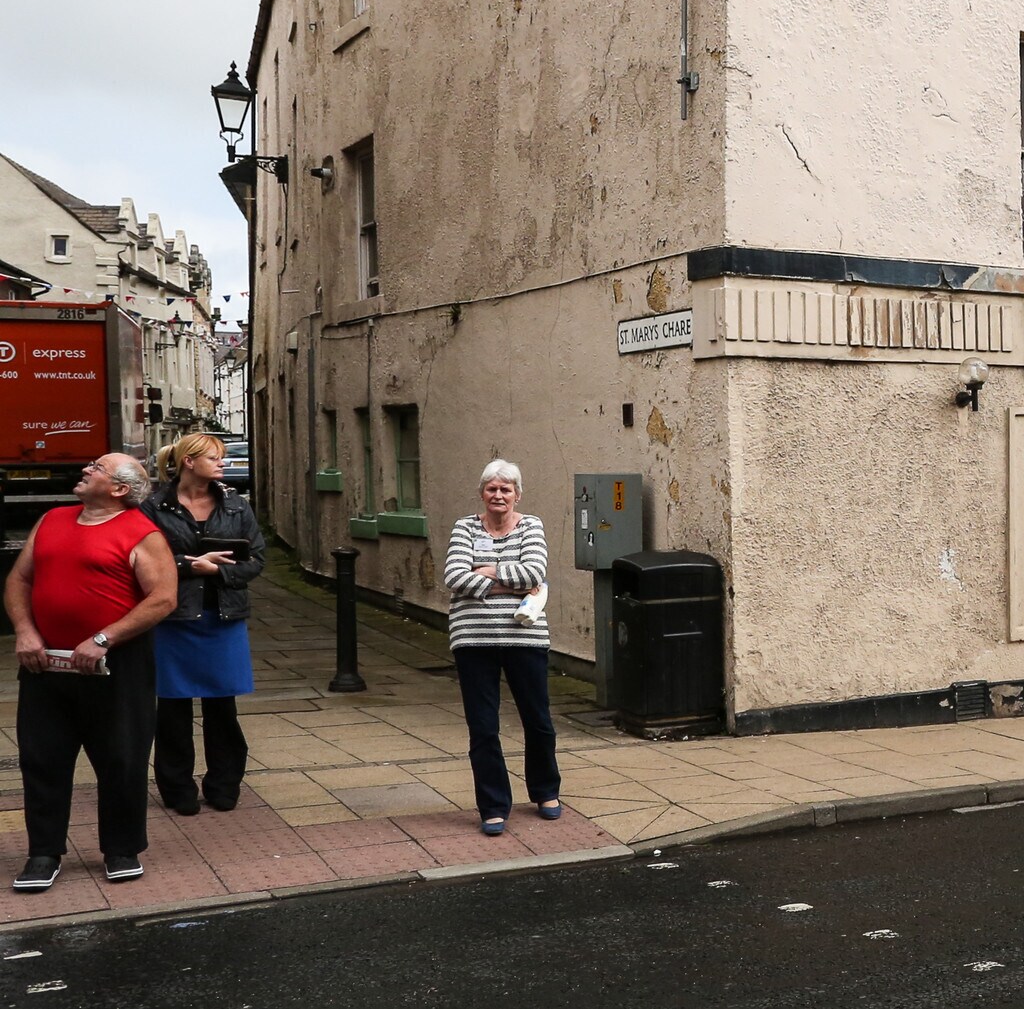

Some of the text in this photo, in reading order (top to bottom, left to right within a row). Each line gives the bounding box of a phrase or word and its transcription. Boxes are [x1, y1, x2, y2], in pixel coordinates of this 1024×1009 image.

[57, 309, 84, 320] 2816
[620, 319, 691, 345] ST. MARYS CHARE
[32, 349, 86, 361] express
[34, 371, 96, 379] www.tnt.co.uk
[22, 420, 95, 430] sure we can
[49, 659, 71, 668] un
